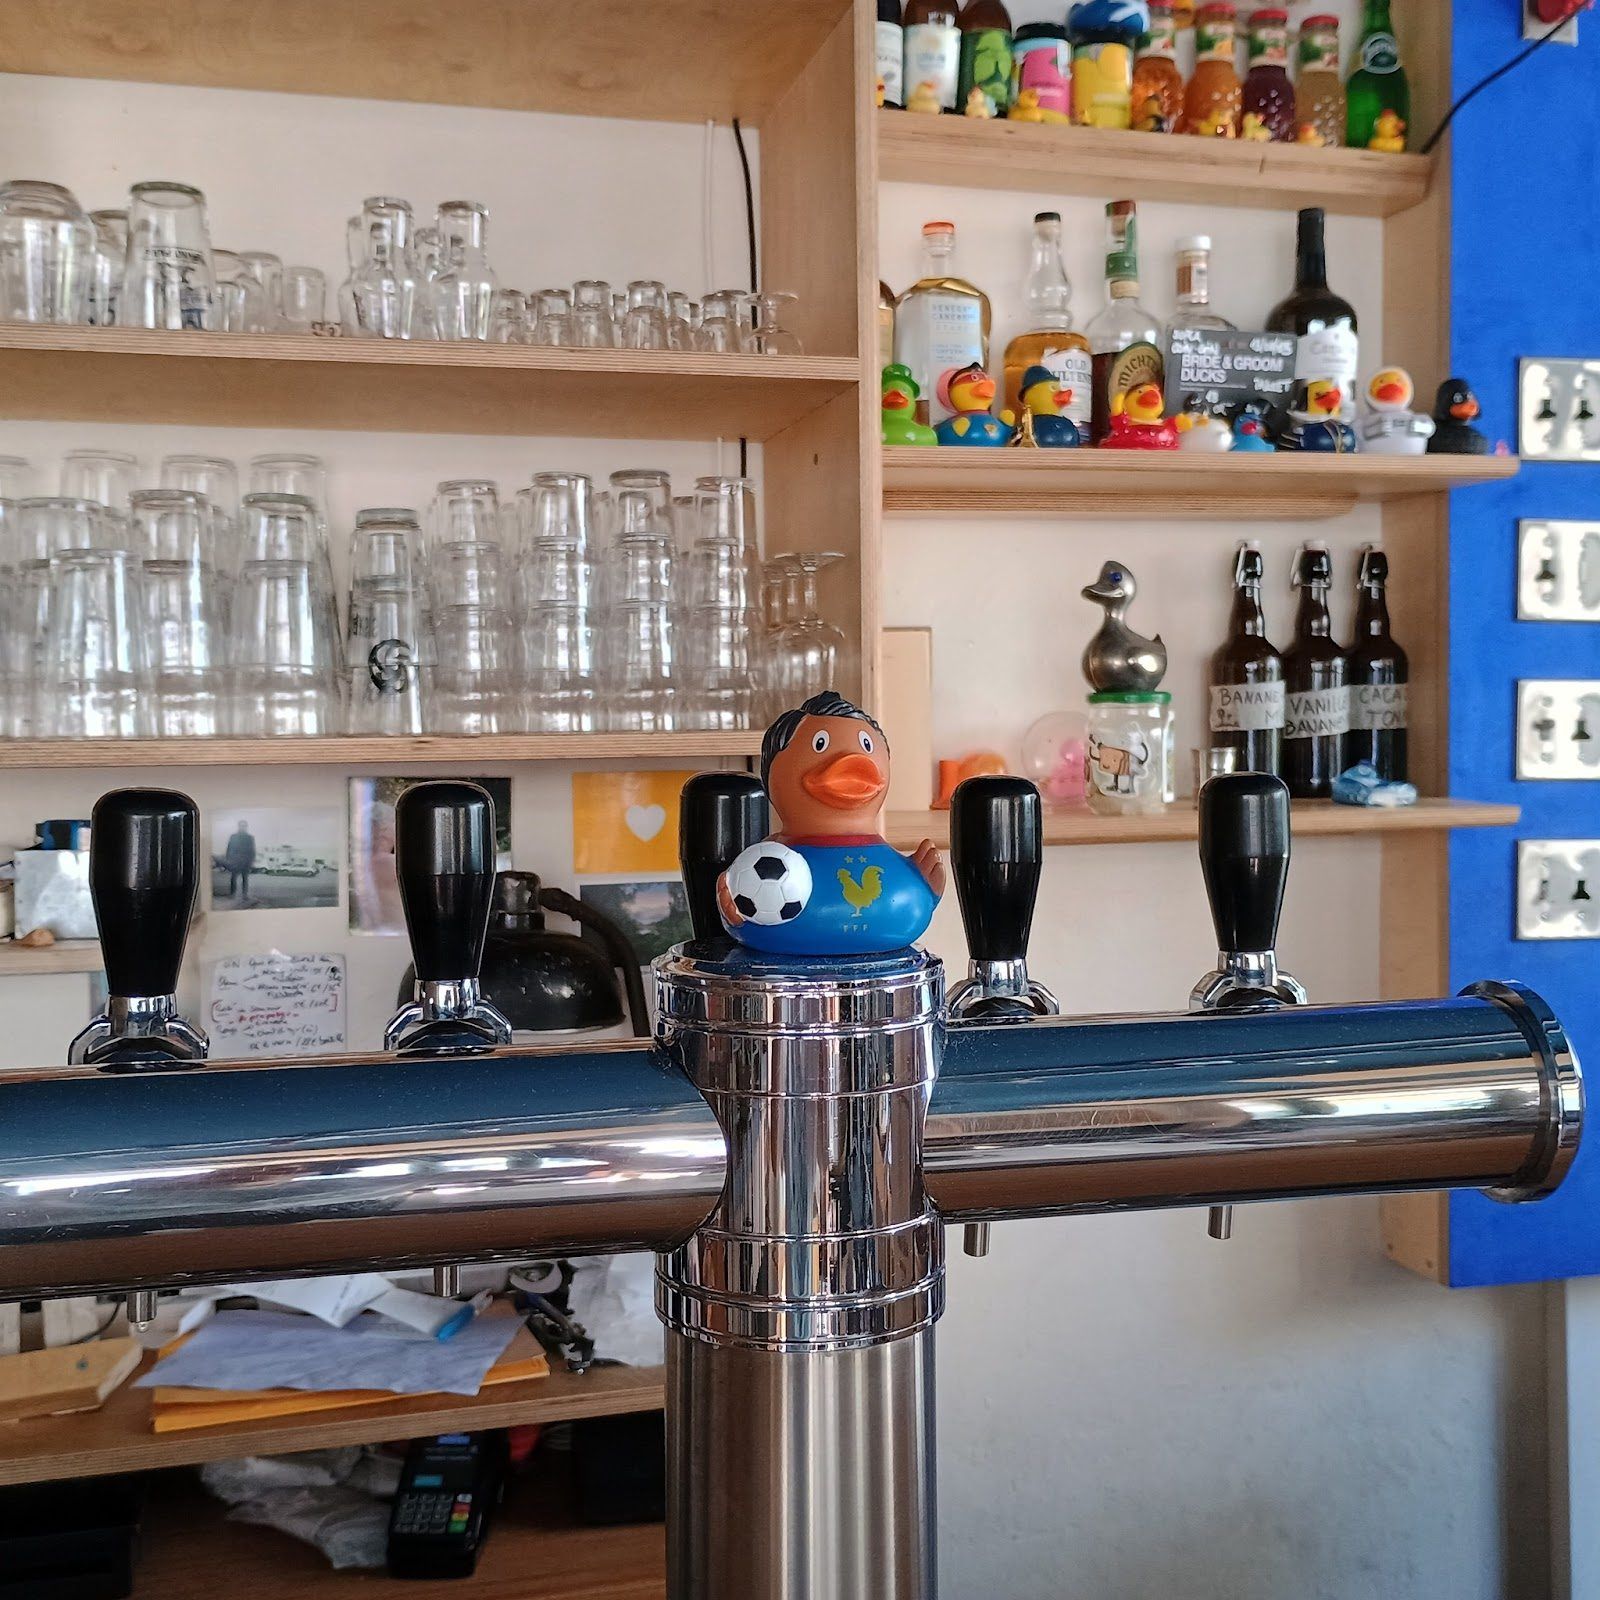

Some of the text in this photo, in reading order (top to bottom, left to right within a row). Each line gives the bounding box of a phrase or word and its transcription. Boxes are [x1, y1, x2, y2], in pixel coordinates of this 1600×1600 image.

[1065, 359, 1088, 370] OLD
[1118, 354, 1157, 387] MICHT
[1181, 354, 1285, 372] BRIDE & GROOM
[1180, 369, 1227, 383] DUCKS
[1360, 687, 1403, 704] CACA
